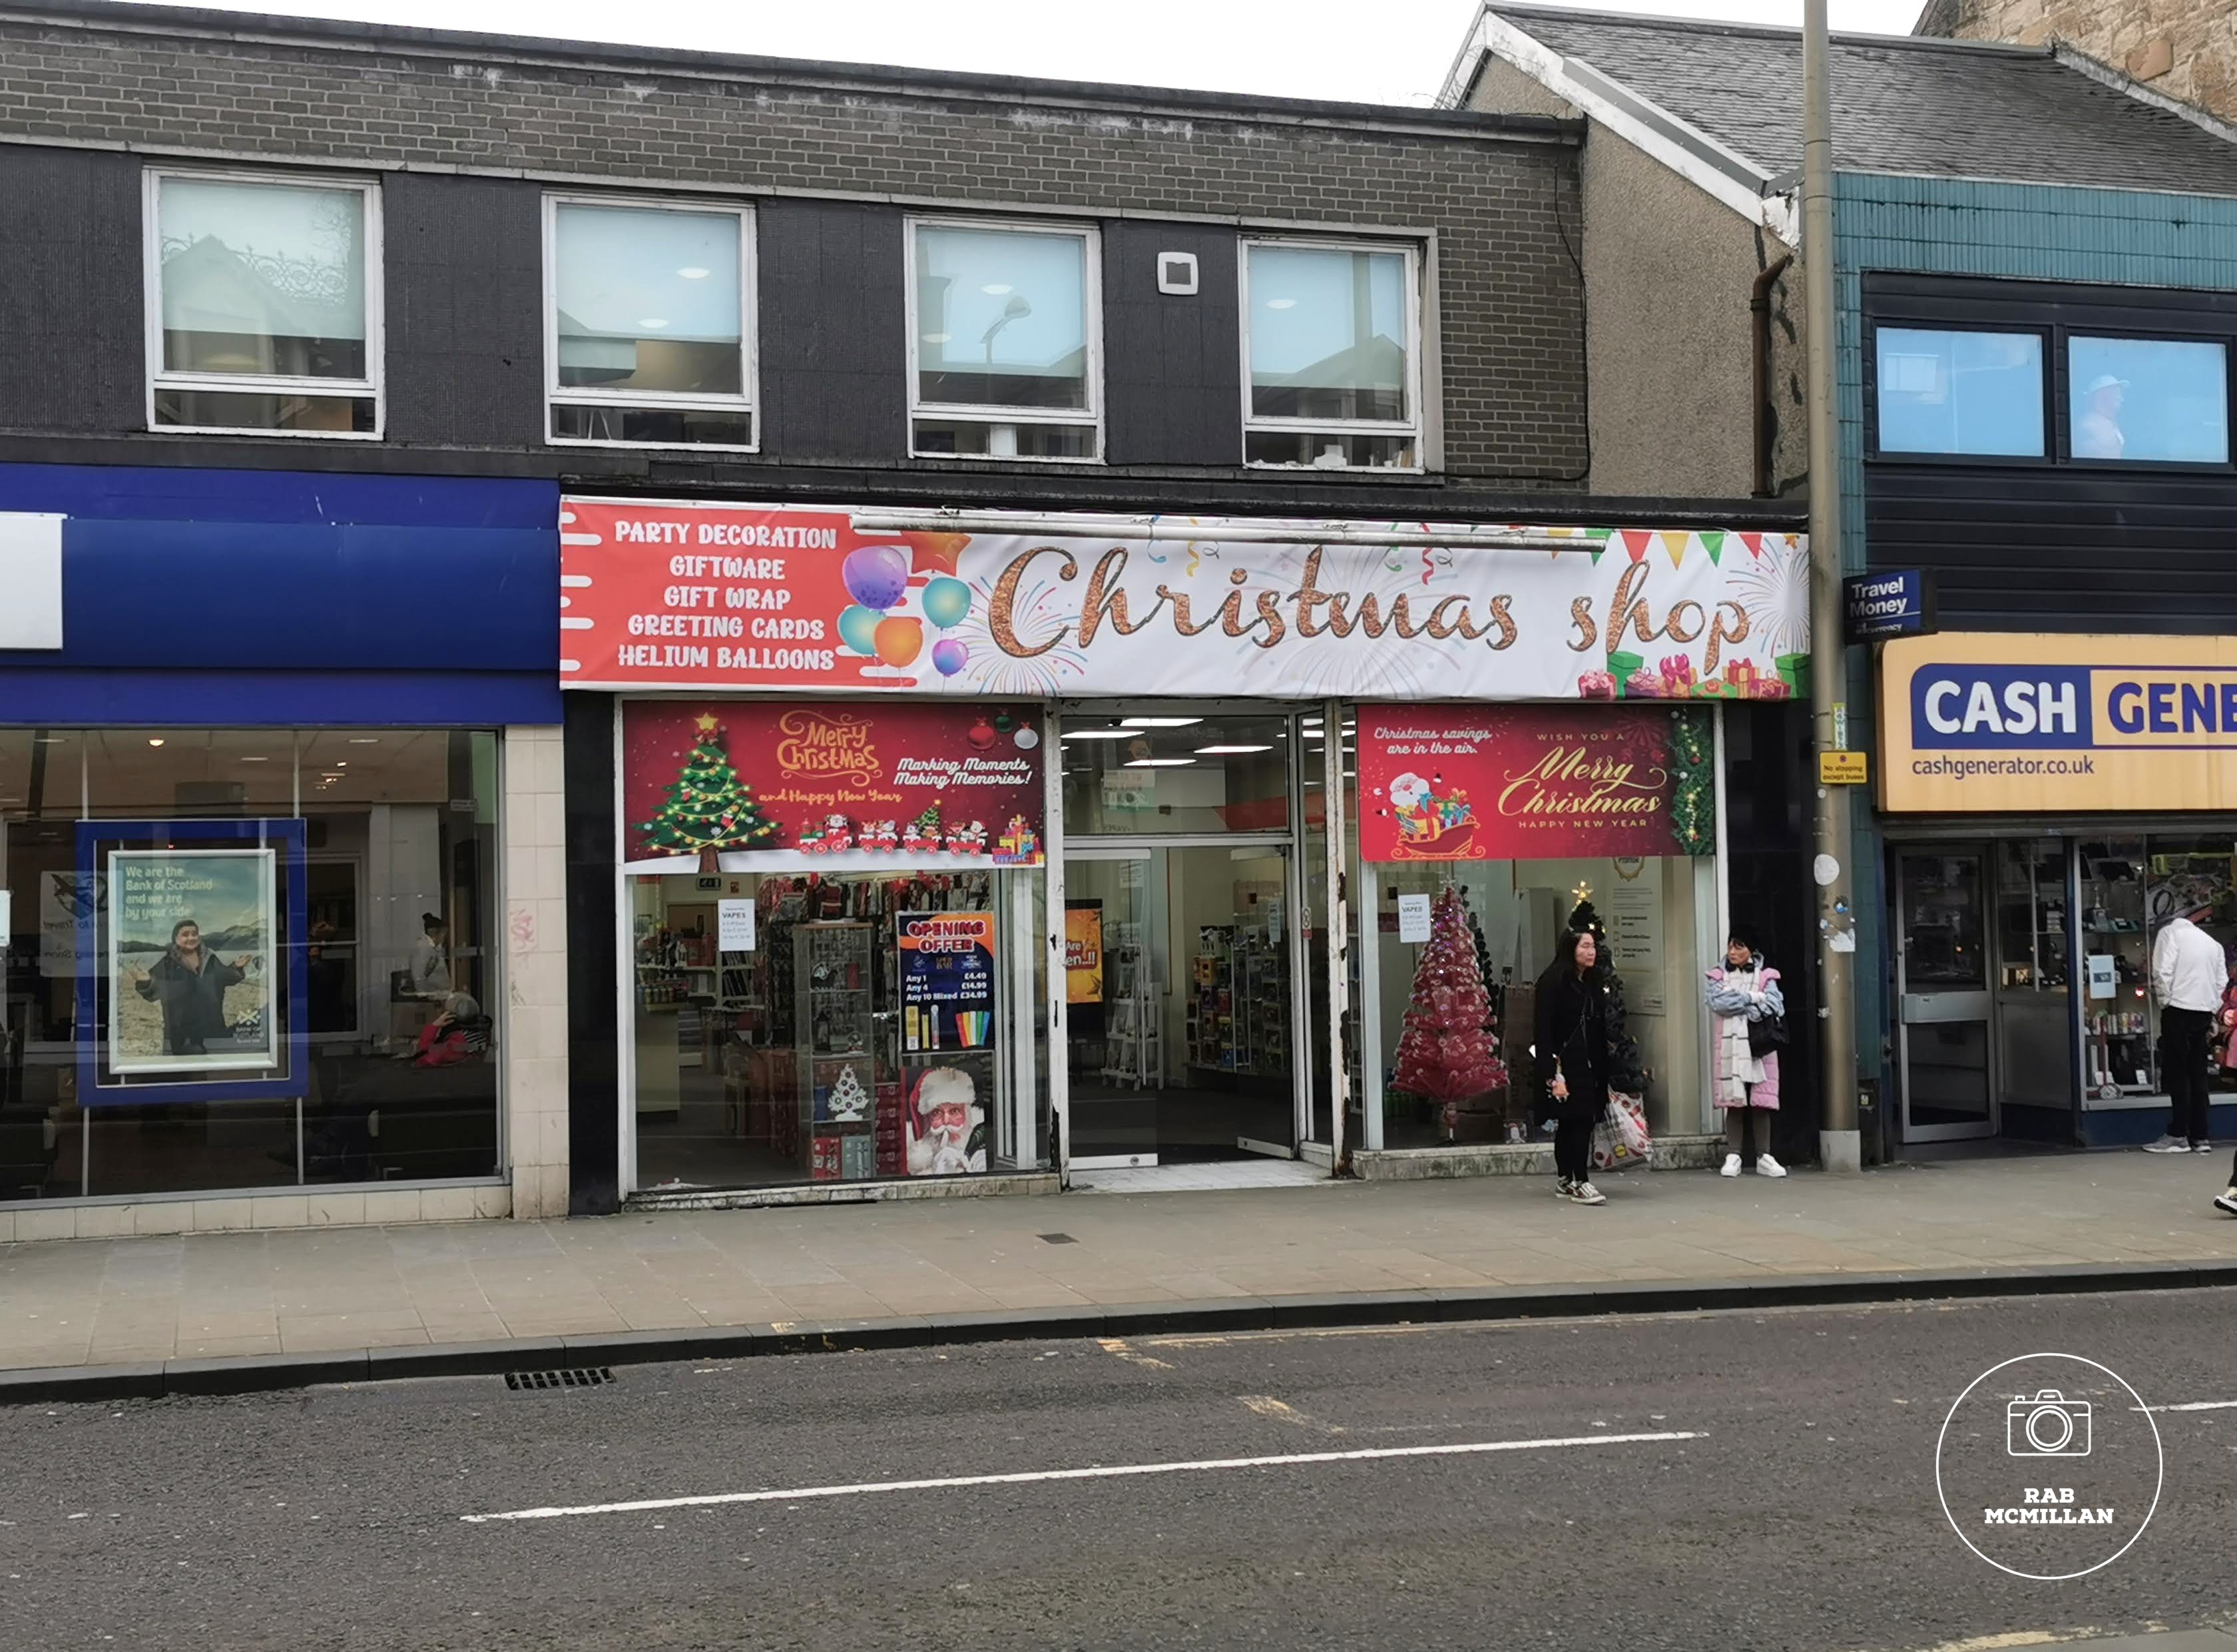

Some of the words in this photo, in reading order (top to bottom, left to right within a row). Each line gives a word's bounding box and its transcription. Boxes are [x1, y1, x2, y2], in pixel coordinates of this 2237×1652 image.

[615, 521, 691, 543] PARTY
[698, 524, 836, 549] DECORATION
[670, 556, 784, 579] GIFTWARE
[1852, 577, 1903, 598] Travel
[664, 586, 718, 608] GIFT
[724, 588, 791, 610] WRAP
[1850, 598, 1907, 617] Money
[988, 543, 1518, 659] Christmas
[1567, 558, 1751, 678] shop
[628, 615, 743, 637] GREETING
[751, 617, 825, 640] CARDS
[618, 645, 708, 667] HELIUM
[717, 647, 835, 671] BALLOONS
[1925, 681, 2077, 734] CASH
[798, 721, 866, 748] Merry
[1374, 726, 1438, 739] Christmas
[1443, 730, 1492, 742] savings
[776, 738, 879, 770] Christmas
[1387, 744, 1410, 755] are
[1414, 744, 1427, 755] in
[1430, 743, 1451, 754] the
[1453, 743, 1477, 754] air.
[897, 758, 961, 776] Marking
[963, 757, 1030, 770] Moments
[1503, 746, 1667, 792] Merry
[1912, 755, 2095, 780] cashgenerator.co.uk
[893, 772, 950, 790] Making
[952, 770, 1032, 785] Memories!
[758, 788, 788, 802] and
[789, 789, 834, 806] Happy
[868, 788, 902, 802] Year
[1498, 779, 1662, 816] Christmas
[1519, 820, 1565, 828] HAPPY
[1573, 819, 1604, 828] NEW
[1611, 818, 1647, 827] YEAR
[125, 866, 142, 877] We
[144, 868, 163, 877] are
[165, 866, 184, 876] the
[126, 880, 152, 890] Bank
[154, 879, 166, 890] of
[167, 878, 213, 890] Scotland
[126, 894, 146, 904] and
[148, 895, 163, 904] we
[125, 906, 139, 920] by
[142, 908, 166, 920] your
[168, 906, 192, 917] side
[907, 920, 985, 937] OPENING
[919, 938, 974, 953] OFFER
[1067, 942, 1081, 951] Are
